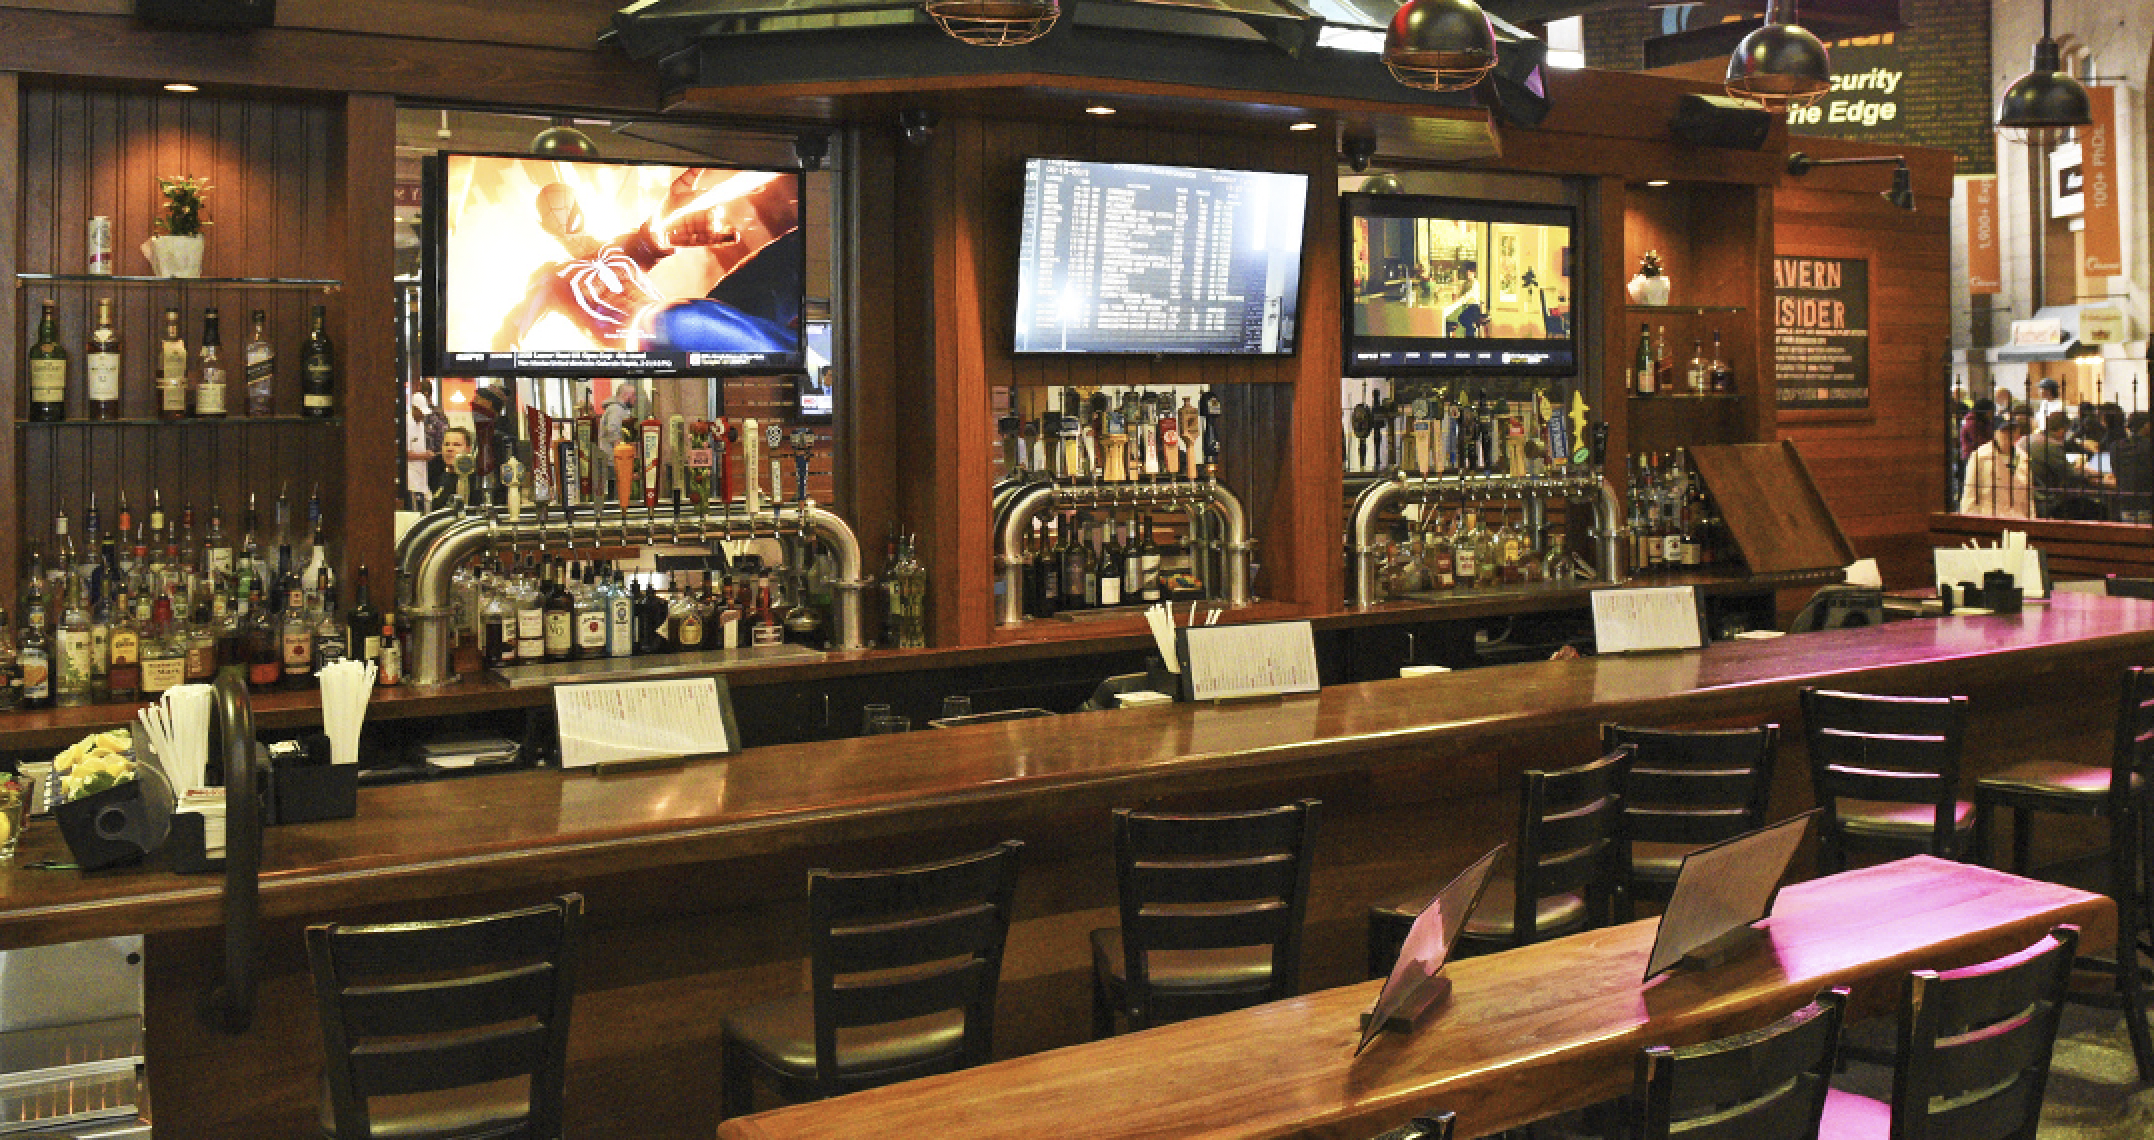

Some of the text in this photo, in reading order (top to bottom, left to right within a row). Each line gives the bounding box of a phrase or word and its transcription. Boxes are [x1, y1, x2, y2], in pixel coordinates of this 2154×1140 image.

[1786, 100, 1897, 126] he Edge
[2092, 171, 2107, 208] 100+
